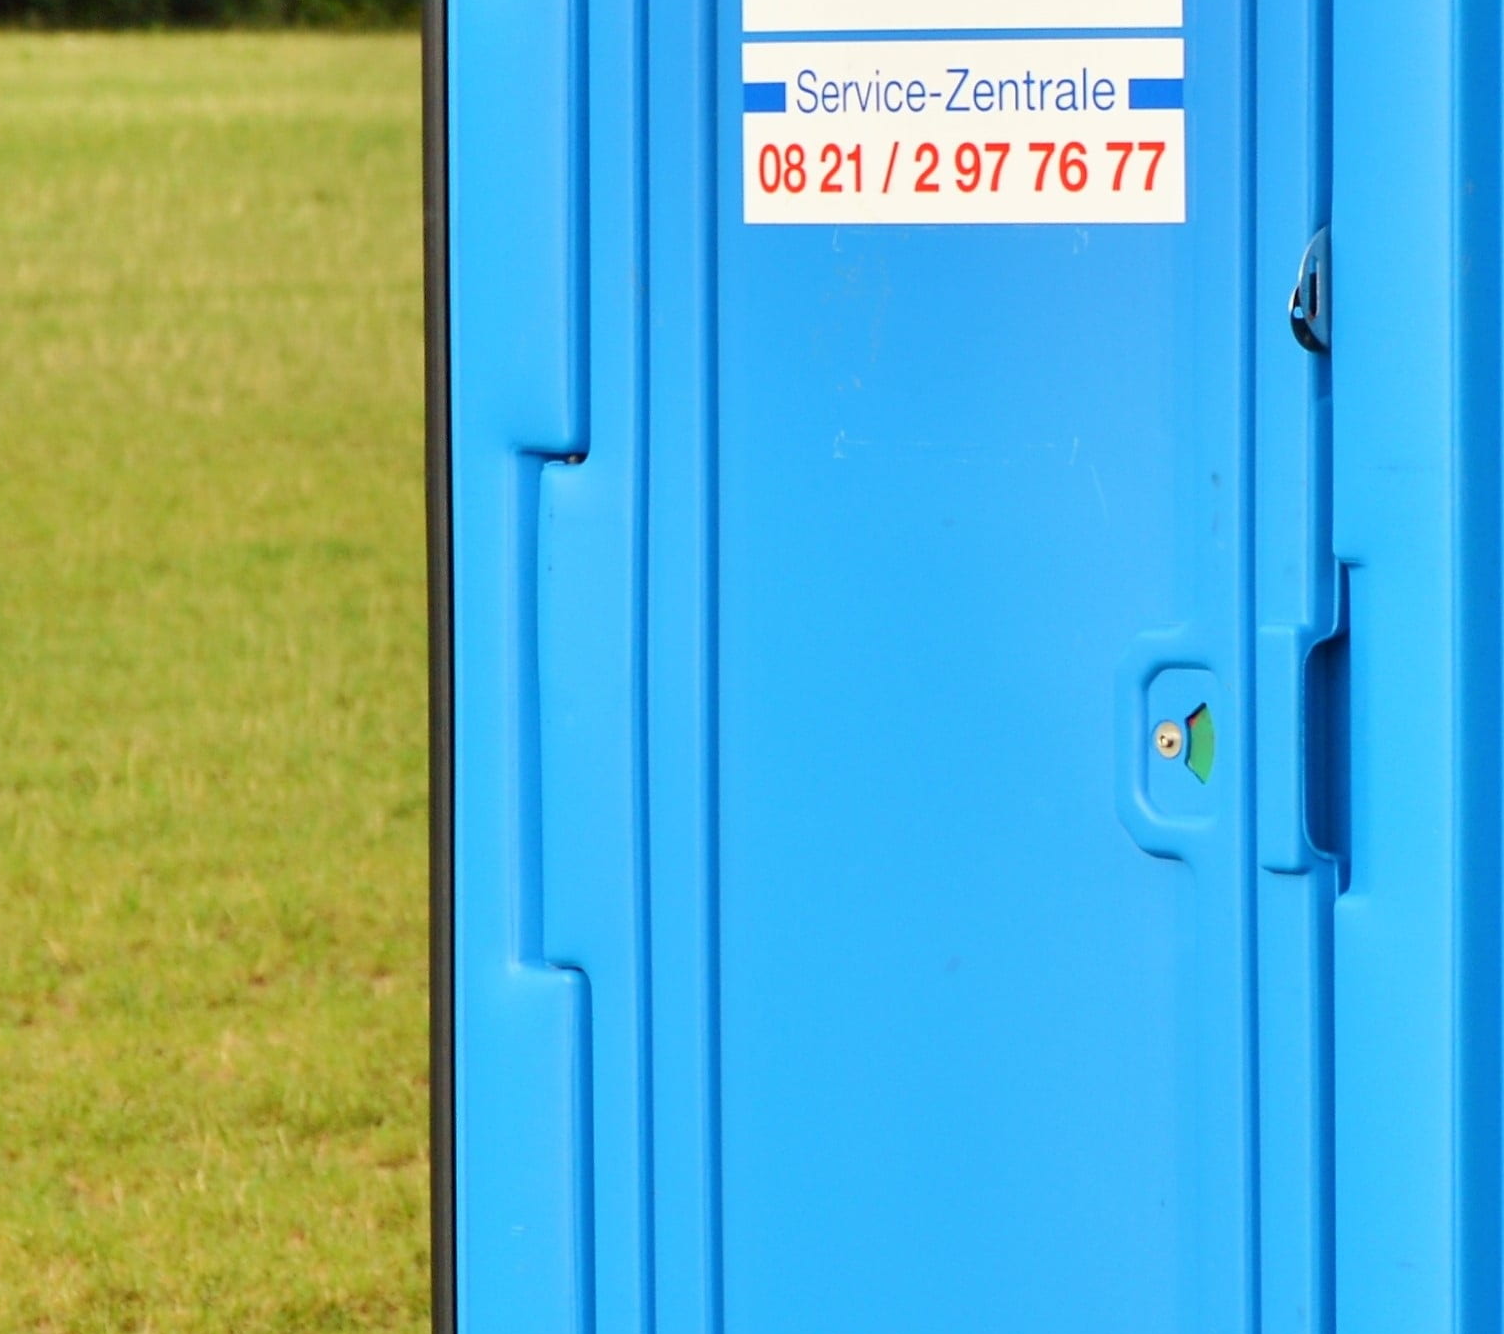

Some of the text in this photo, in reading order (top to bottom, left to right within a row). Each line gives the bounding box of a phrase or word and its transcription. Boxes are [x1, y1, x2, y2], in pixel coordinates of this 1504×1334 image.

[795, 67, 1116, 113] Service-Zentrale
[758, 143, 807, 194] 08
[819, 143, 862, 193] 21
[914, 142, 940, 193] 2
[954, 142, 1011, 194] 97
[1028, 141, 1088, 193] 76
[1106, 141, 1166, 192] 77
